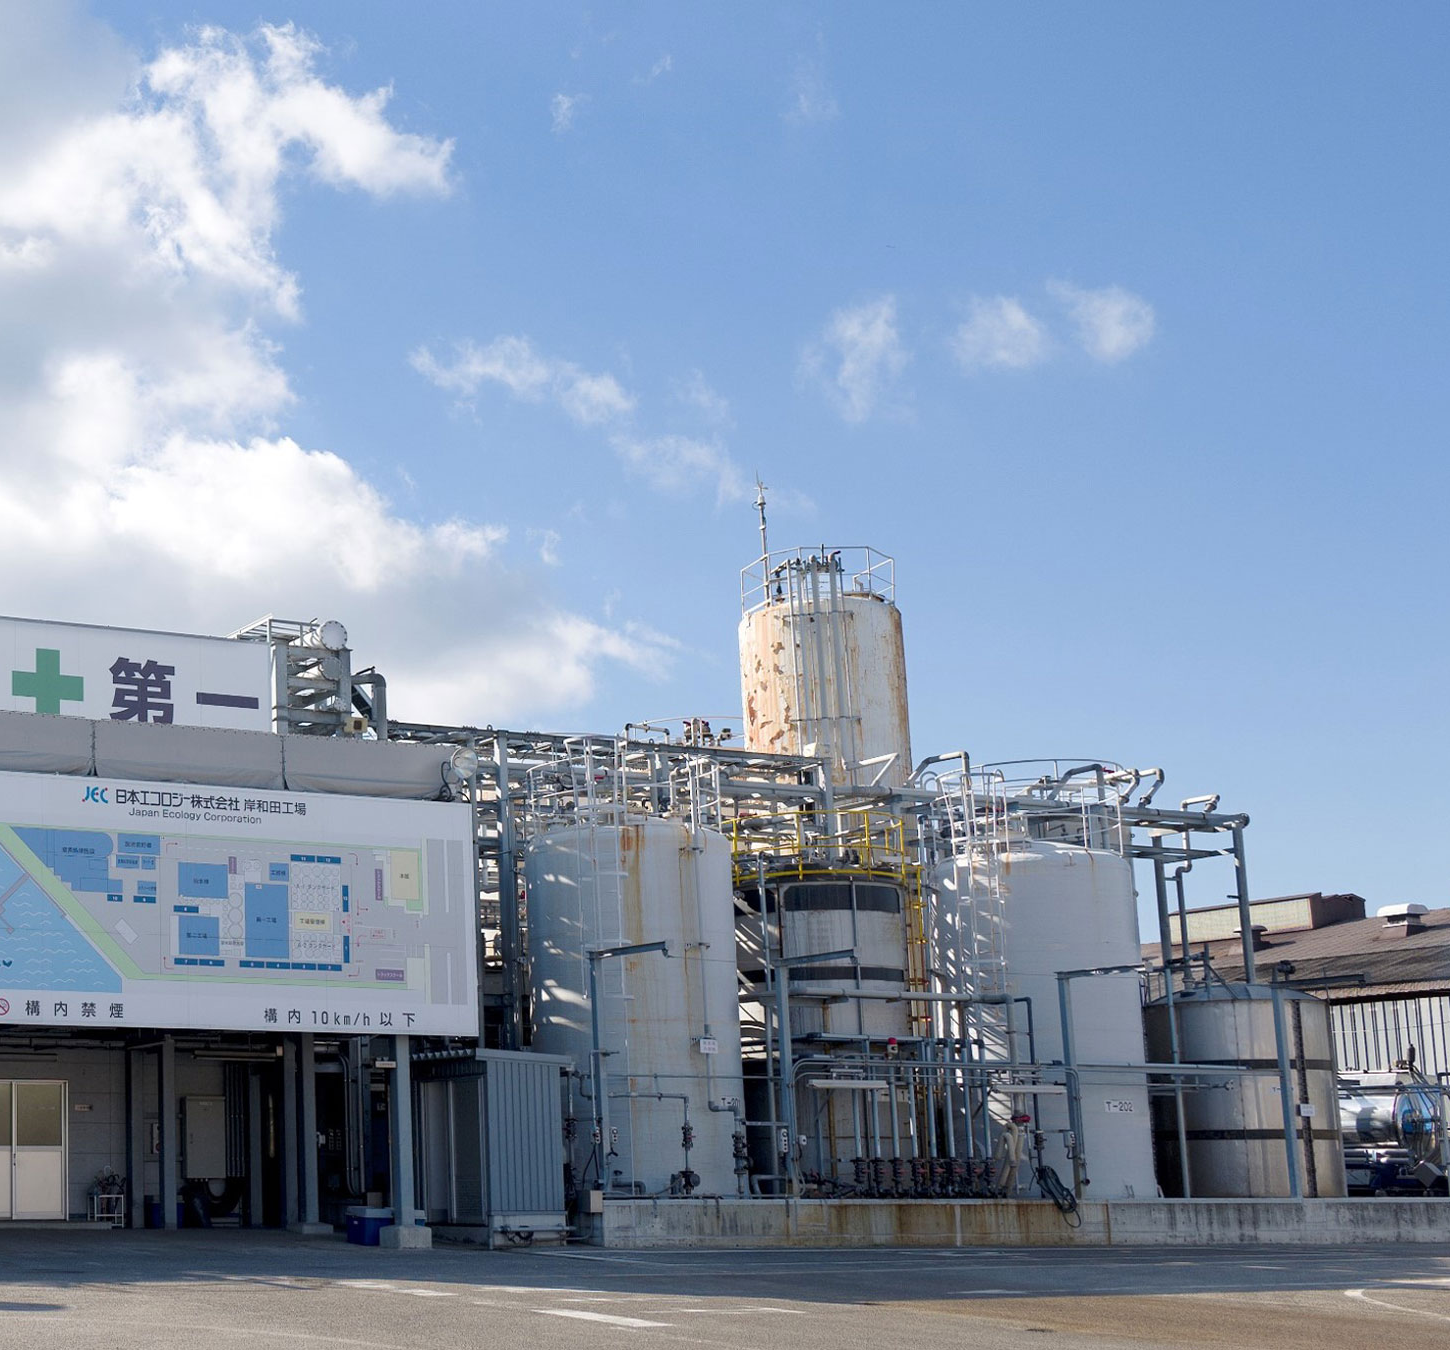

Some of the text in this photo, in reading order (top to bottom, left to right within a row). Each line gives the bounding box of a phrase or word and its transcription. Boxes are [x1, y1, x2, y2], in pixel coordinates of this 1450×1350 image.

[109, 656, 259, 724] 第一
[81, 786, 307, 816] JEC 日本エコロジー株式会社 岸和田工場
[129, 808, 262, 825] Japan Ecology Corporation
[25, 1000, 124, 1019] 構内禁煙
[1106, 1101, 1133, 1112] T-202
